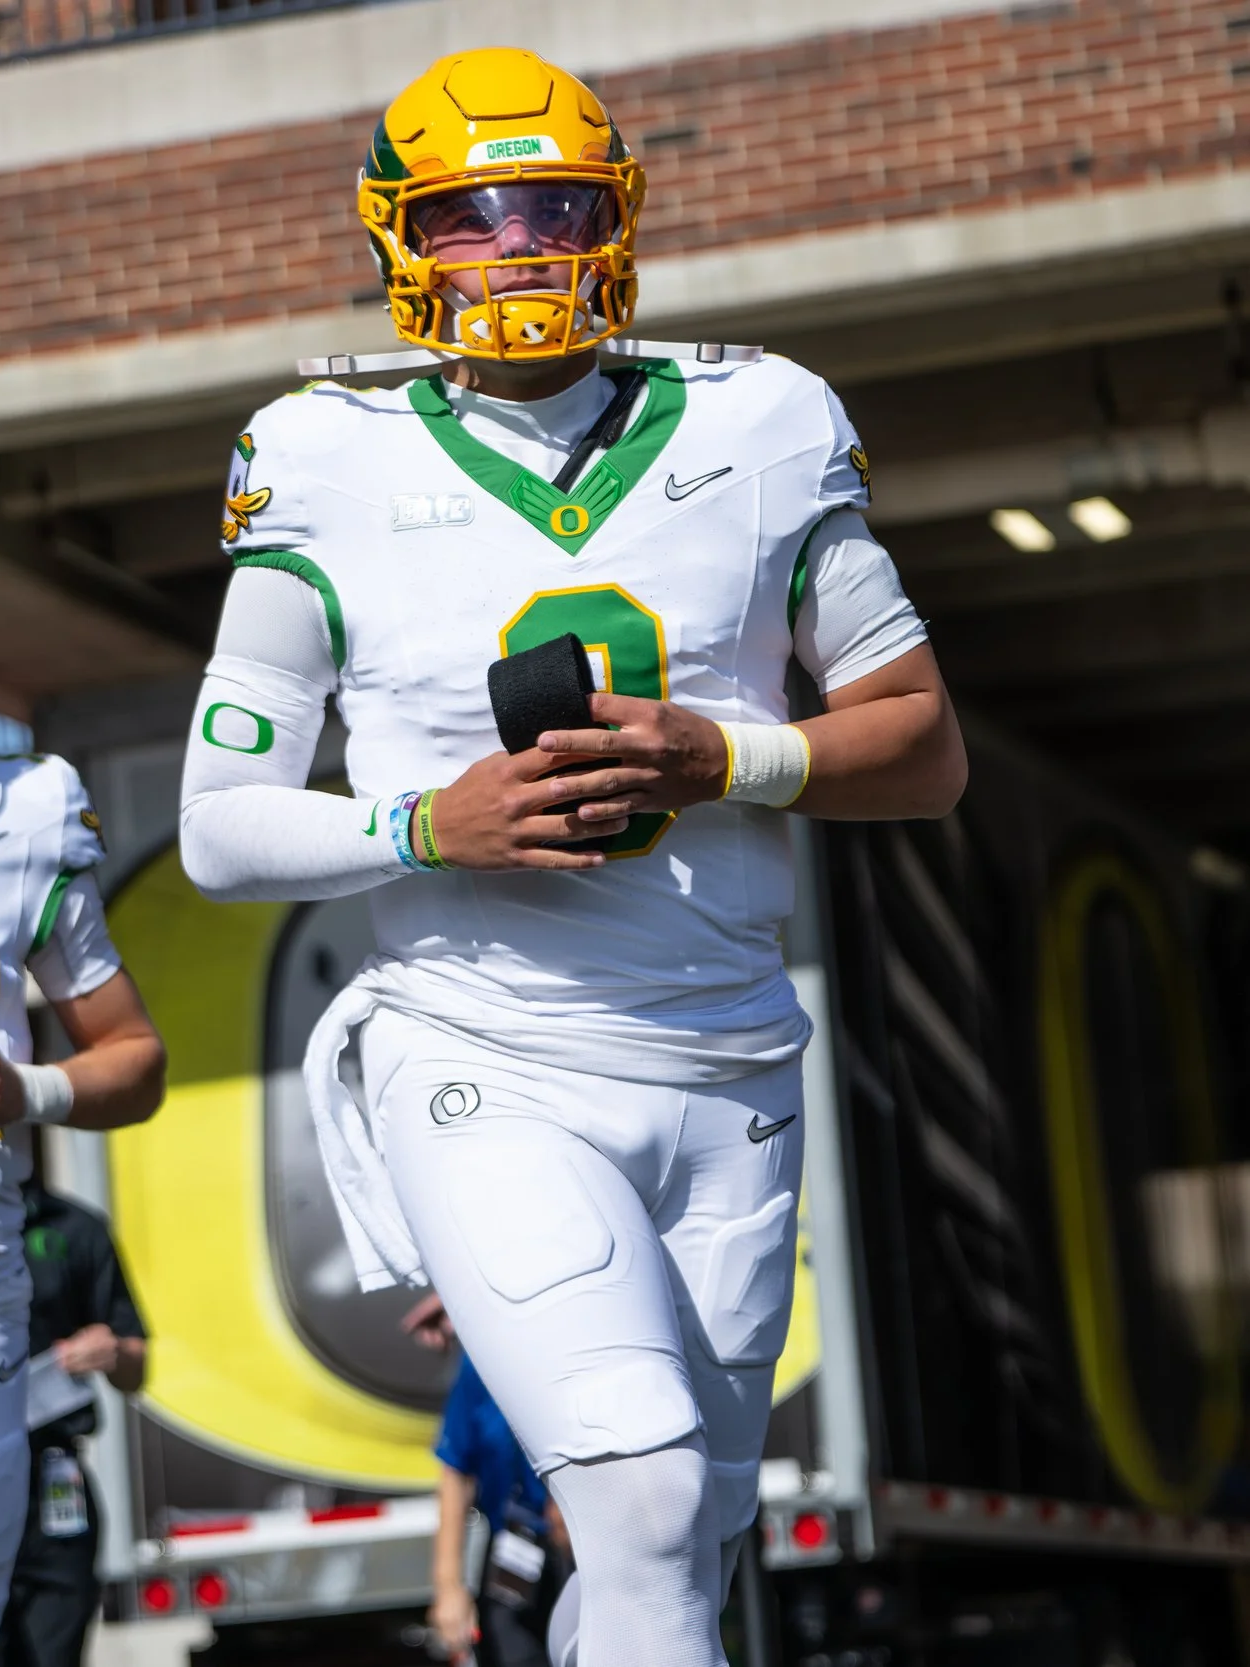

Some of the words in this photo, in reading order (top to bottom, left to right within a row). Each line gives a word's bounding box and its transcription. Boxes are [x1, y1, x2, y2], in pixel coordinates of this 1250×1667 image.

[486, 138, 543, 160] OREGON
[550, 505, 590, 538] O
[203, 702, 274, 754] O
[421, 814, 437, 857] OREGON
